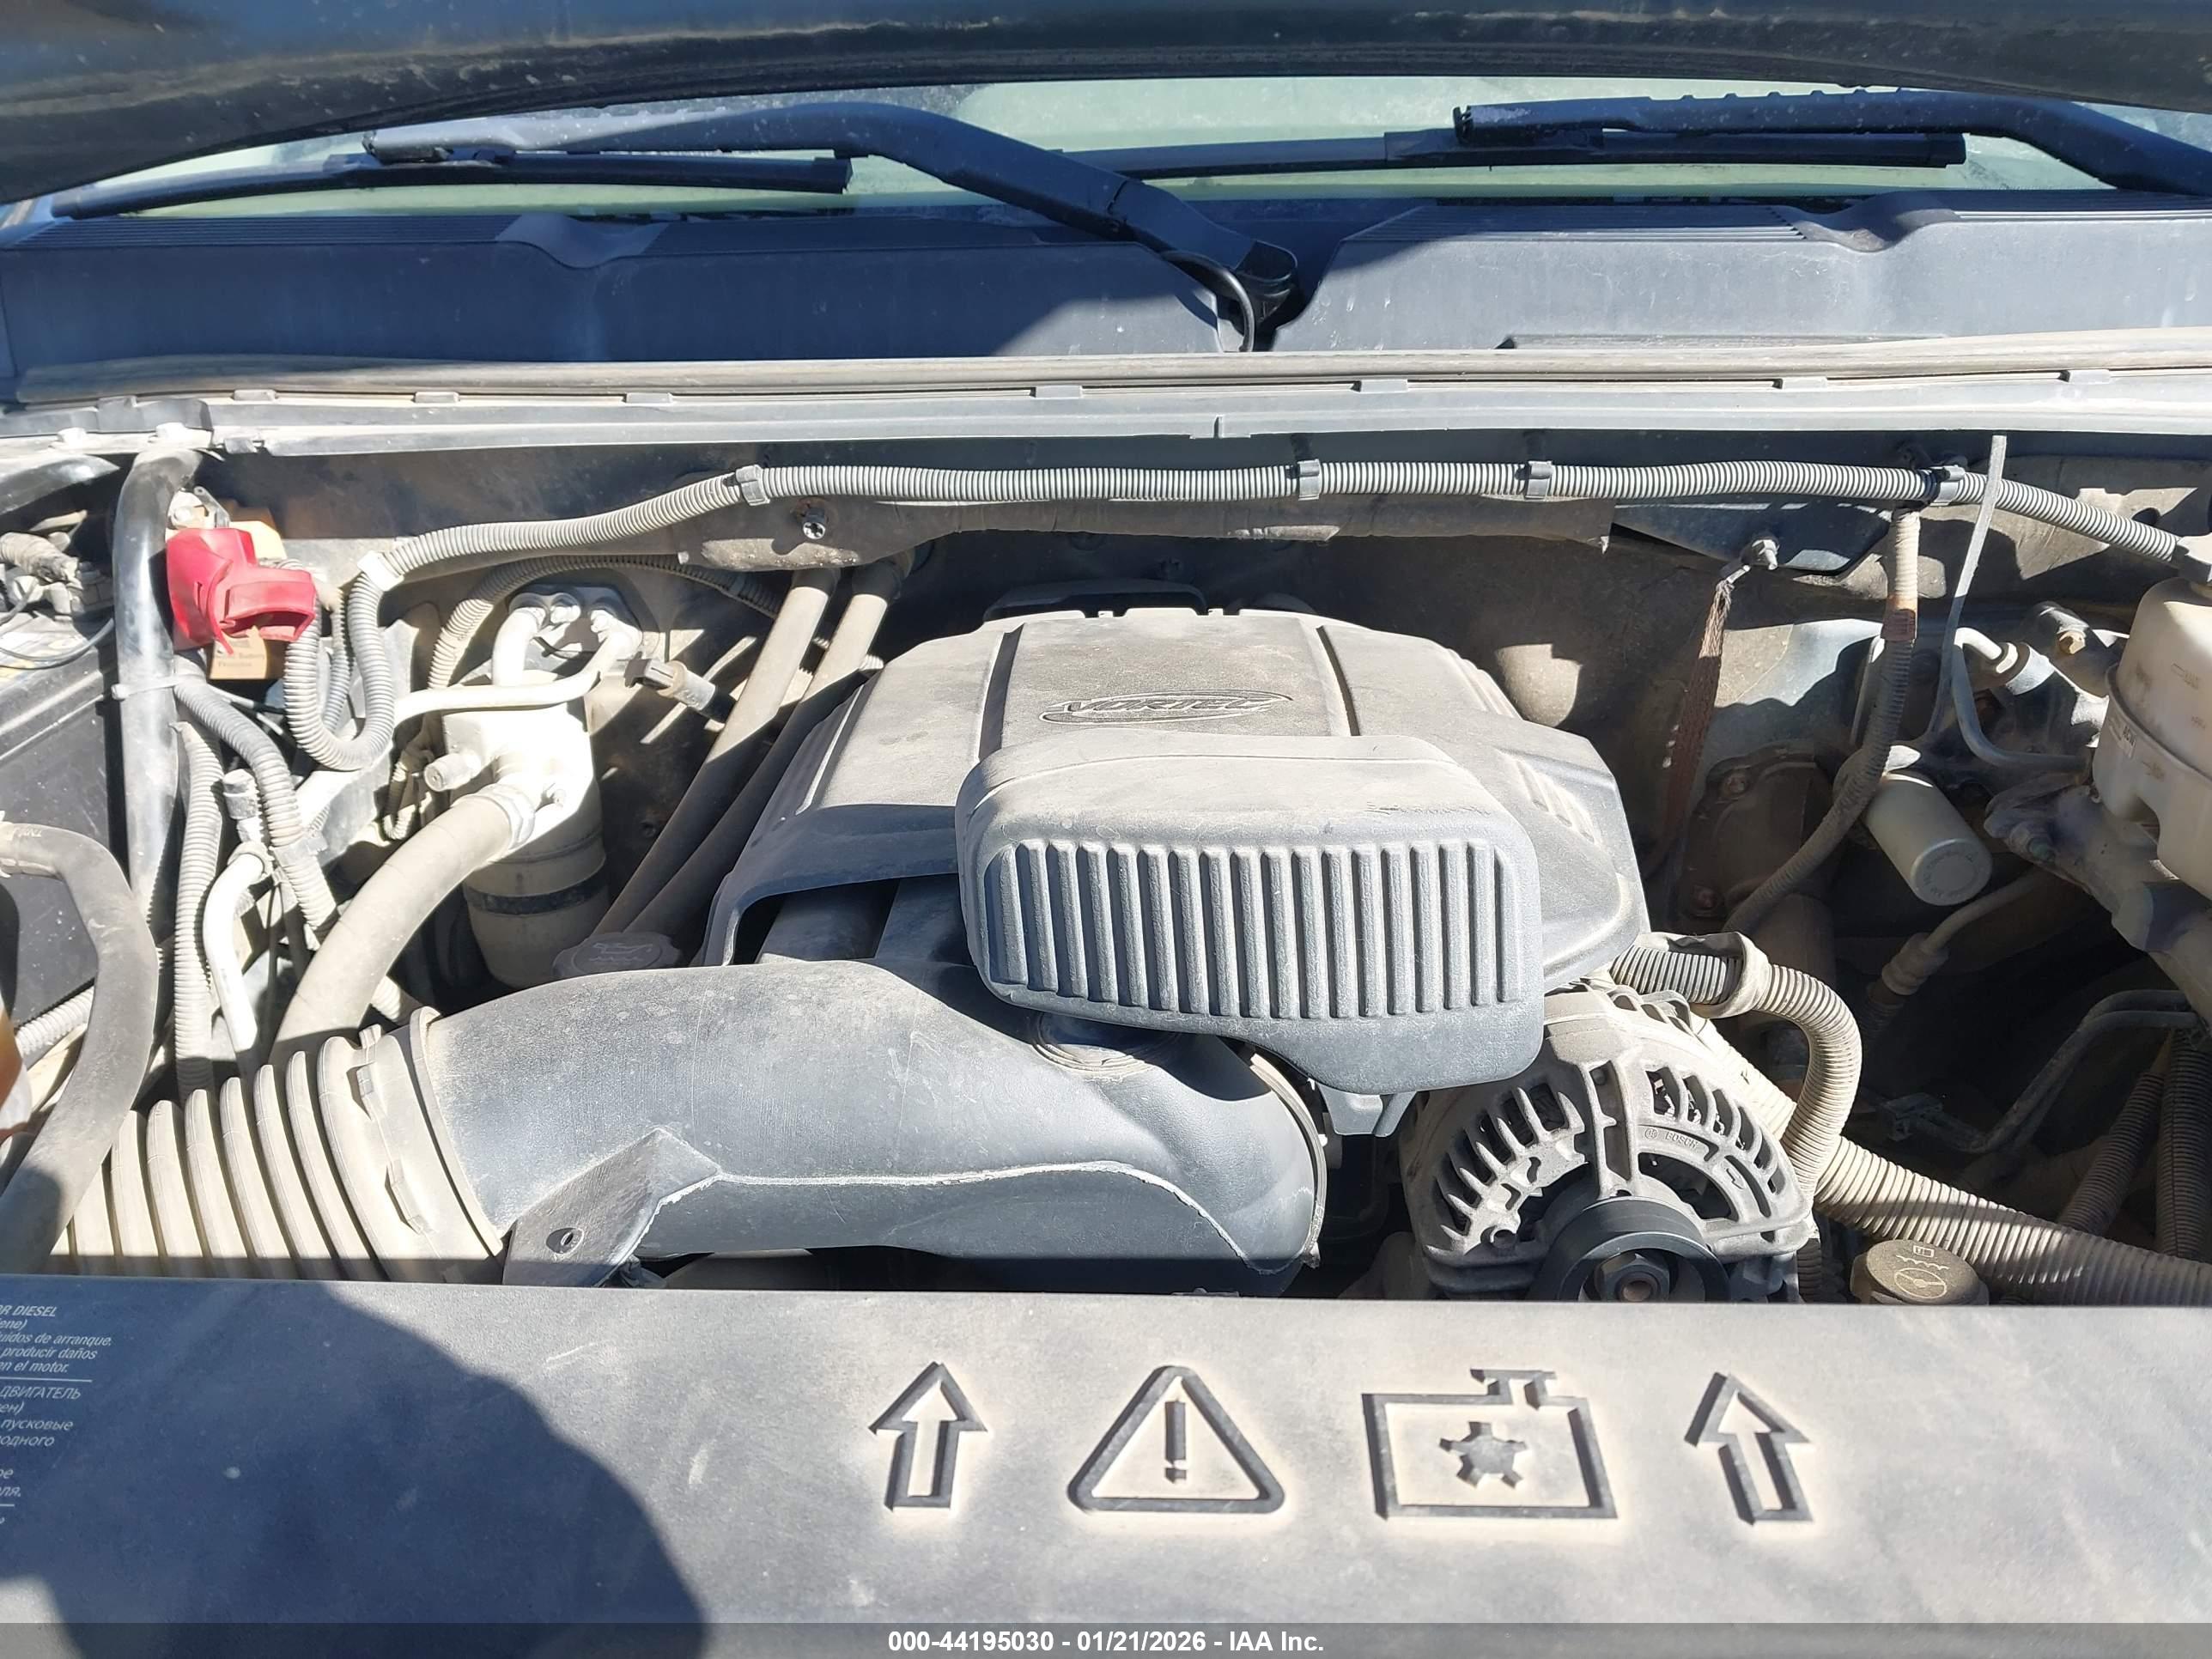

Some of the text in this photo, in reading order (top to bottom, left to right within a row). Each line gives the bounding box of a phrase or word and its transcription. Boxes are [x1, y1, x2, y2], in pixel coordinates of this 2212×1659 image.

[1665, 1131, 1698, 1148] BOSCH
[12, 1305, 58, 1317] DIESEL
[0, 1318, 27, 1331] ene)
[0, 1331, 112, 1347] uidos de arranque.
[0, 1346, 98, 1360] producir daños
[14, 1360, 29, 1371] el
[28, 1362, 69, 1373] motor.
[0, 1385, 82, 1400] ДВИГАТЕЛЬ
[0, 1401, 25, 1416] ен)
[1, 1419, 74, 1432] пусковые
[0, 1436, 55, 1448] одного
